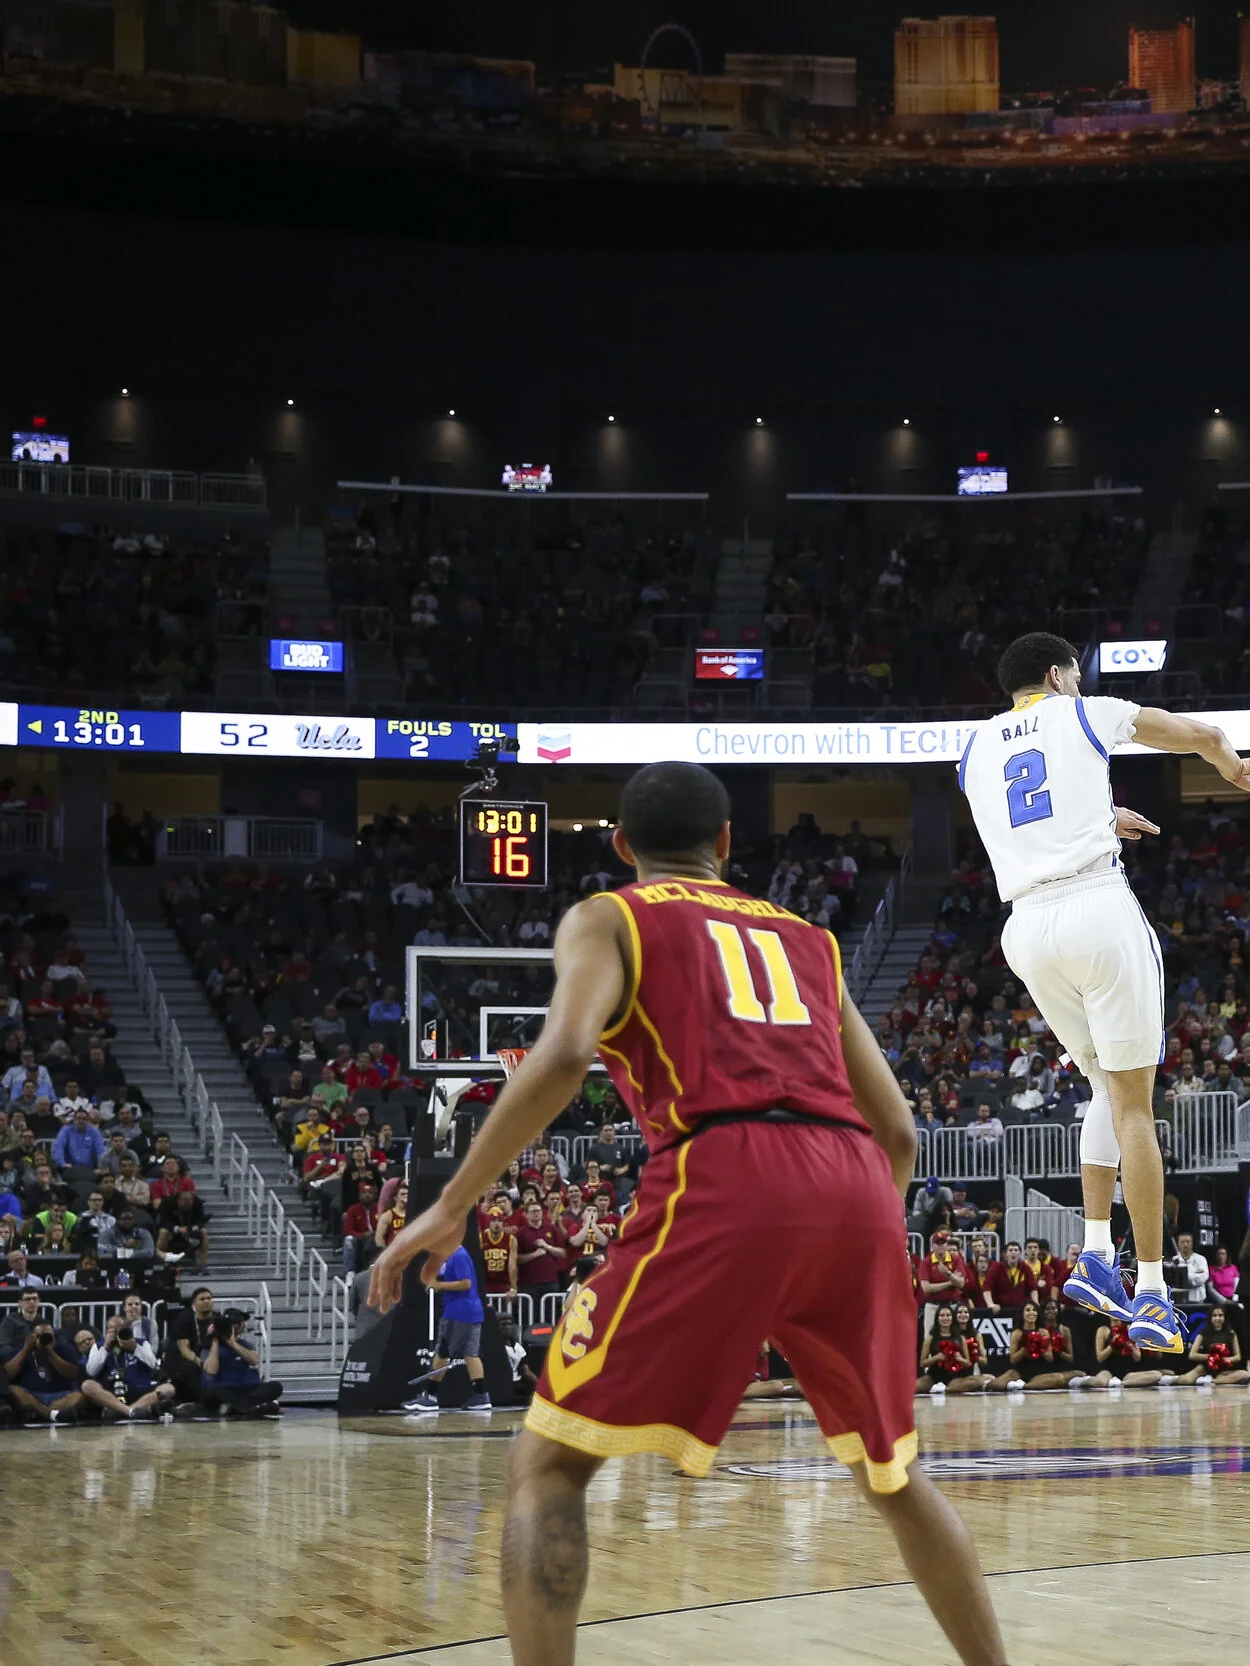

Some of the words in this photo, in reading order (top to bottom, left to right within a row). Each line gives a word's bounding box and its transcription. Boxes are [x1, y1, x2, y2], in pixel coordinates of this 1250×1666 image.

[78, 710, 119, 724] 2ND
[387, 720, 453, 736] FOULS
[1001, 716, 1039, 742] BALL
[53, 720, 145, 746] 13:01
[220, 723, 268, 747] 52
[469, 723, 506, 738] TOL
[696, 727, 805, 755] Chevron
[815, 726, 870, 755] with
[409, 735, 429, 758] 2
[1004, 748, 1053, 829] 2
[478, 810, 537, 834] 13:01
[493, 836, 529, 877] 16
[706, 919, 812, 1025] 11
